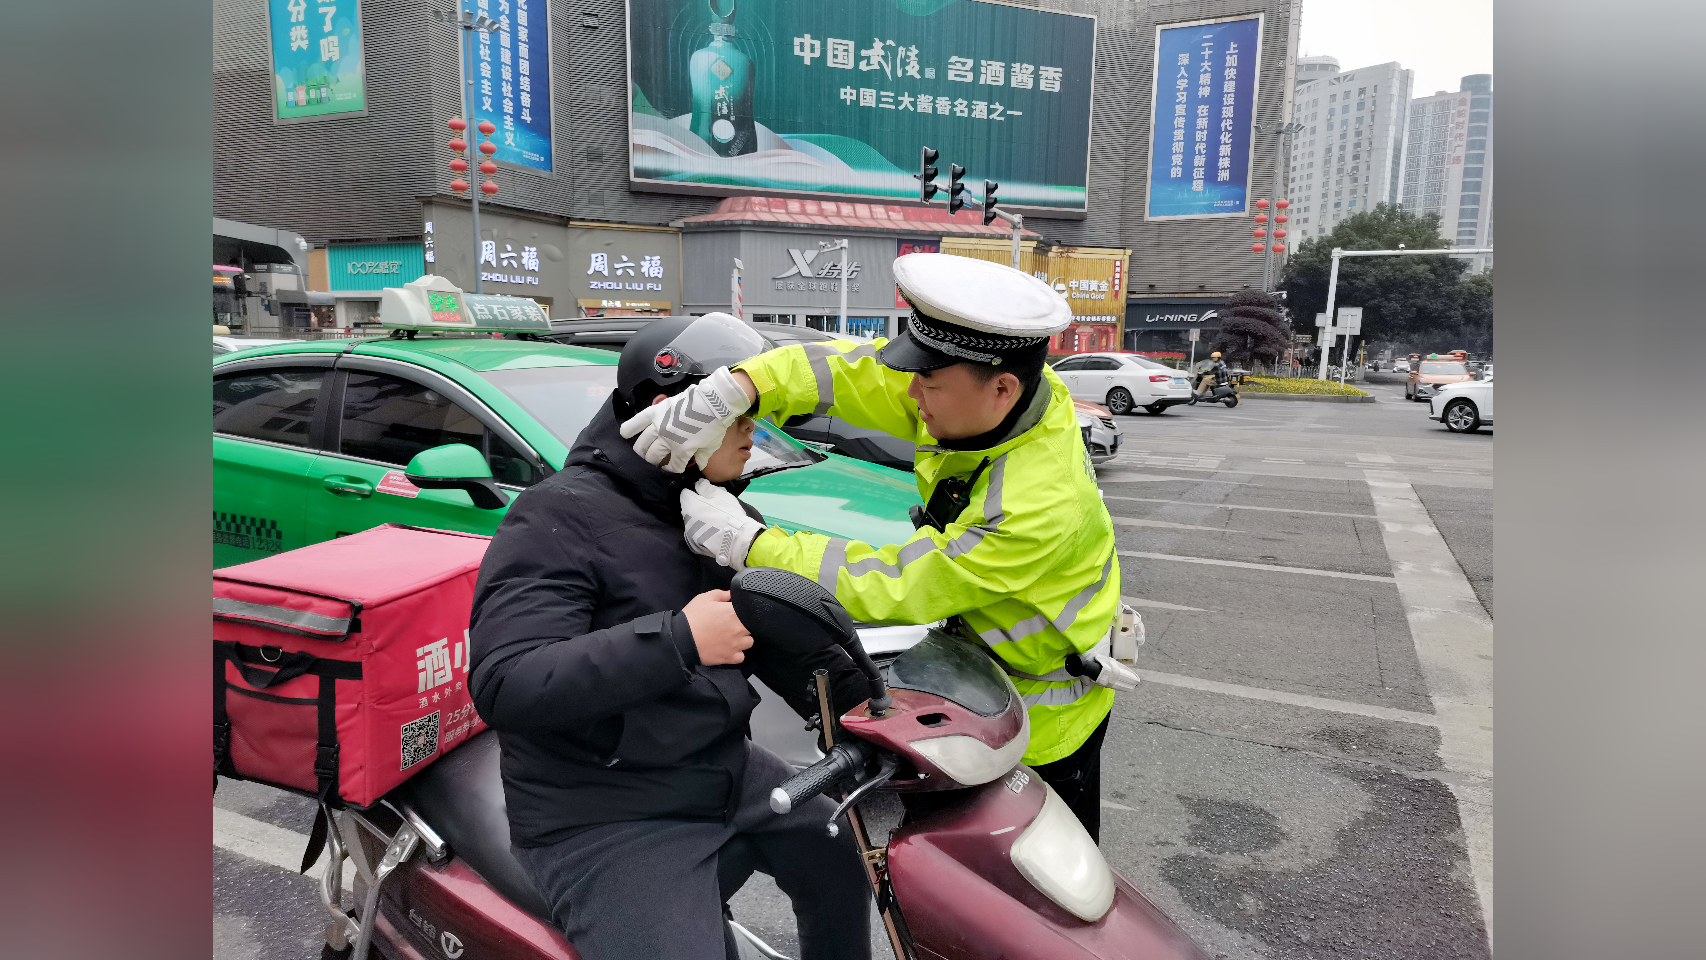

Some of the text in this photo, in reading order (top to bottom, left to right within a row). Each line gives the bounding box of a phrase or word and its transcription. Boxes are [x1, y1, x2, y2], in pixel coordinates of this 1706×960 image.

[317, 0, 340, 62] 了吗
[947, 55, 1063, 93] 名酒酱香
[839, 85, 1023, 121] 中国三大酱香名酒之一
[1170, 53, 1189, 179] 深入学习宣传贯彻党的
[1192, 34, 1214, 192] 二十大精神 在新时代新征程
[1217, 42, 1238, 182] 上加快建设现代化新株洲
[424, 221, 435, 263] 周六福
[480, 240, 540, 273] 周六福
[481, 272, 539, 286] ZHOU LIU FU
[586, 252, 664, 279] 周六福
[589, 280, 662, 291] ZHOU LIU FU
[1069, 278, 1109, 292] 中国黄金
[1090, 292, 1105, 300] Gold
[428, 293, 460, 313] 空车
[472, 303, 545, 322] 点石家装
[1145, 313, 1198, 323] LI-NING
